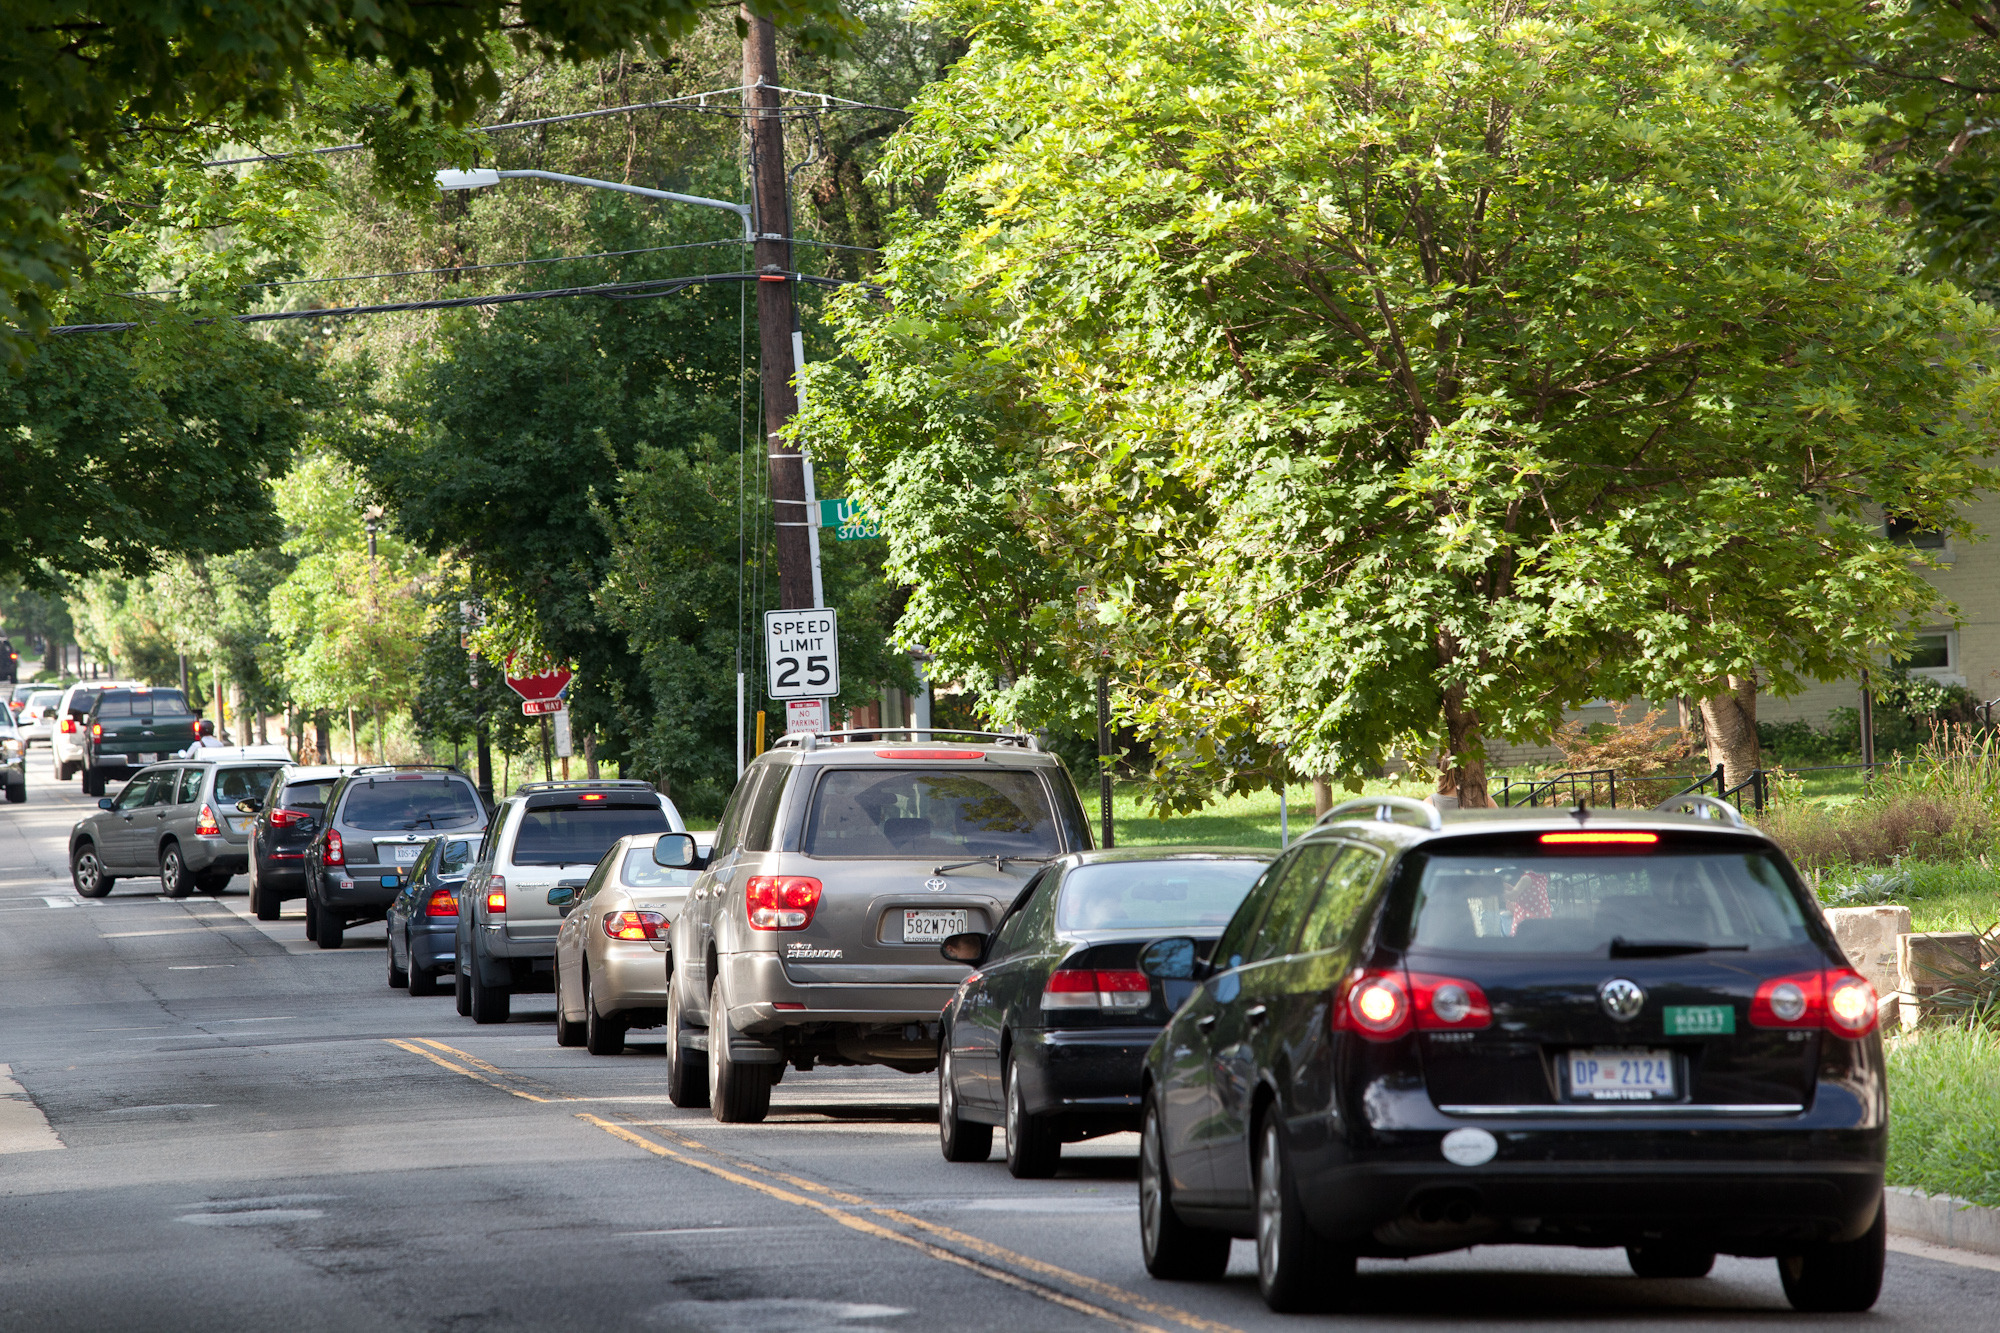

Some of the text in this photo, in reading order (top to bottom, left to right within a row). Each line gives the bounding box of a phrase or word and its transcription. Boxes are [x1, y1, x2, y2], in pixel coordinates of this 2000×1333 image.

[838, 524, 877, 539] 3700
[772, 620, 830, 635] SPEED
[780, 638, 823, 652] LIMIT
[776, 655, 830, 687] 25
[526, 702, 560, 713] ALL WAY
[799, 710, 810, 718] NO
[791, 718, 819, 727] PARKING
[907, 919, 964, 934] 582M790
[786, 949, 842, 959] SEQUOIA
[1575, 1060, 1666, 1084] DP 2124
